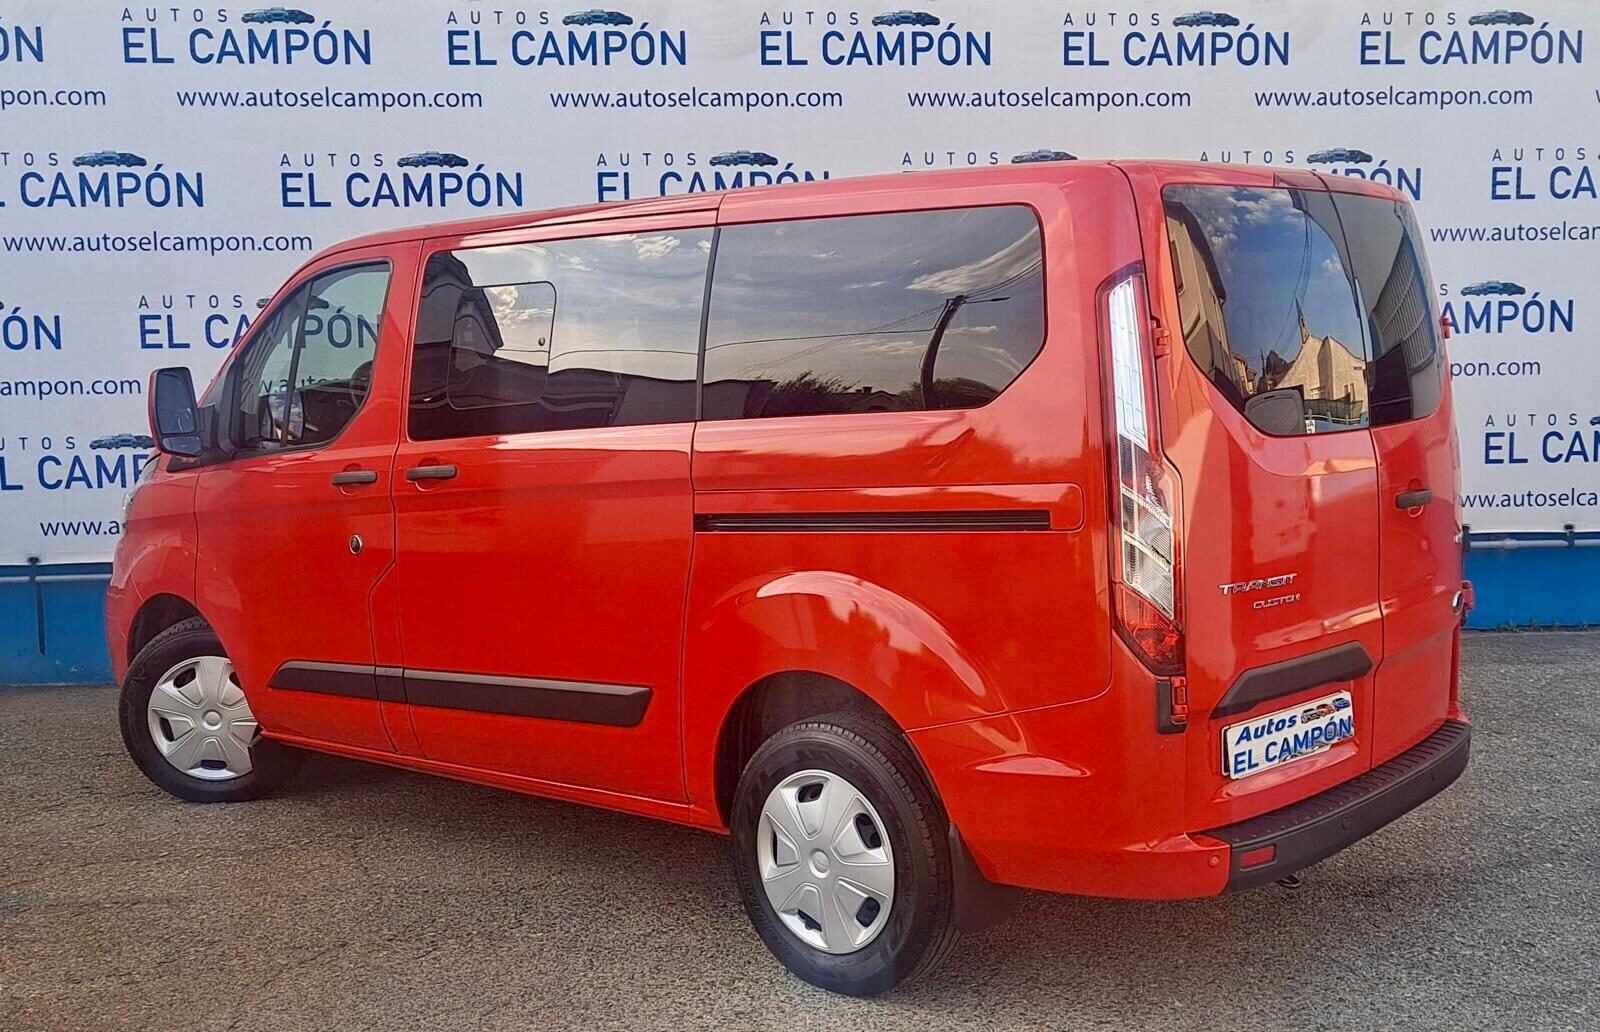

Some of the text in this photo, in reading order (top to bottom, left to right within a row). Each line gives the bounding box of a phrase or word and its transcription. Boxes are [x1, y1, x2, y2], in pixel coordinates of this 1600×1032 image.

[122, 8, 227, 22] AUTOS
[447, 11, 548, 25] AUTOS
[760, 12, 858, 25] AUTOS
[1064, 13, 1159, 26] AUTOS
[1361, 12, 1455, 25] AUTOS
[123, 21, 371, 64] EL CAMPÓN
[448, 23, 686, 66] EL CAMPÓN
[761, 23, 991, 66] EL CAMPÓN
[1064, 24, 1289, 66] EL CAMPÓN
[1361, 22, 1582, 65] EL CAMPÓN
[1, 90, 105, 110] pon.com
[177, 87, 482, 112] www.autoselcampon.com
[550, 87, 842, 112] www.autoselcampon.com
[908, 87, 1190, 112] www.autoselcampon.com
[1255, 86, 1532, 110] www.autoselcampon.com
[280, 154, 383, 167] AUTOS
[597, 153, 696, 166] AUTOS
[902, 152, 998, 165] AUTOS
[1200, 151, 1294, 164] AUTOS
[1492, 148, 1585, 161] AUTOS
[20, 164, 204, 207] CAMPÓN
[281, 164, 523, 207] EL CAMPÓN
[1492, 166, 1597, 200] EL CA
[3, 231, 312, 256] www.autoselcampon.com
[139, 295, 242, 309] AUTOS
[2, 306, 62, 350] ÓN
[140, 315, 190, 349] EL
[1451, 361, 1541, 381] pon.com
[0, 380, 141, 400] ampon.com
[1485, 413, 1577, 427] AUTOS
[1485, 432, 1528, 464] EL
[1219, 572, 1298, 595] TRANSIT
[1235, 714, 1298, 746] Autos
[1233, 715, 1352, 775] EL CAMPÓN
